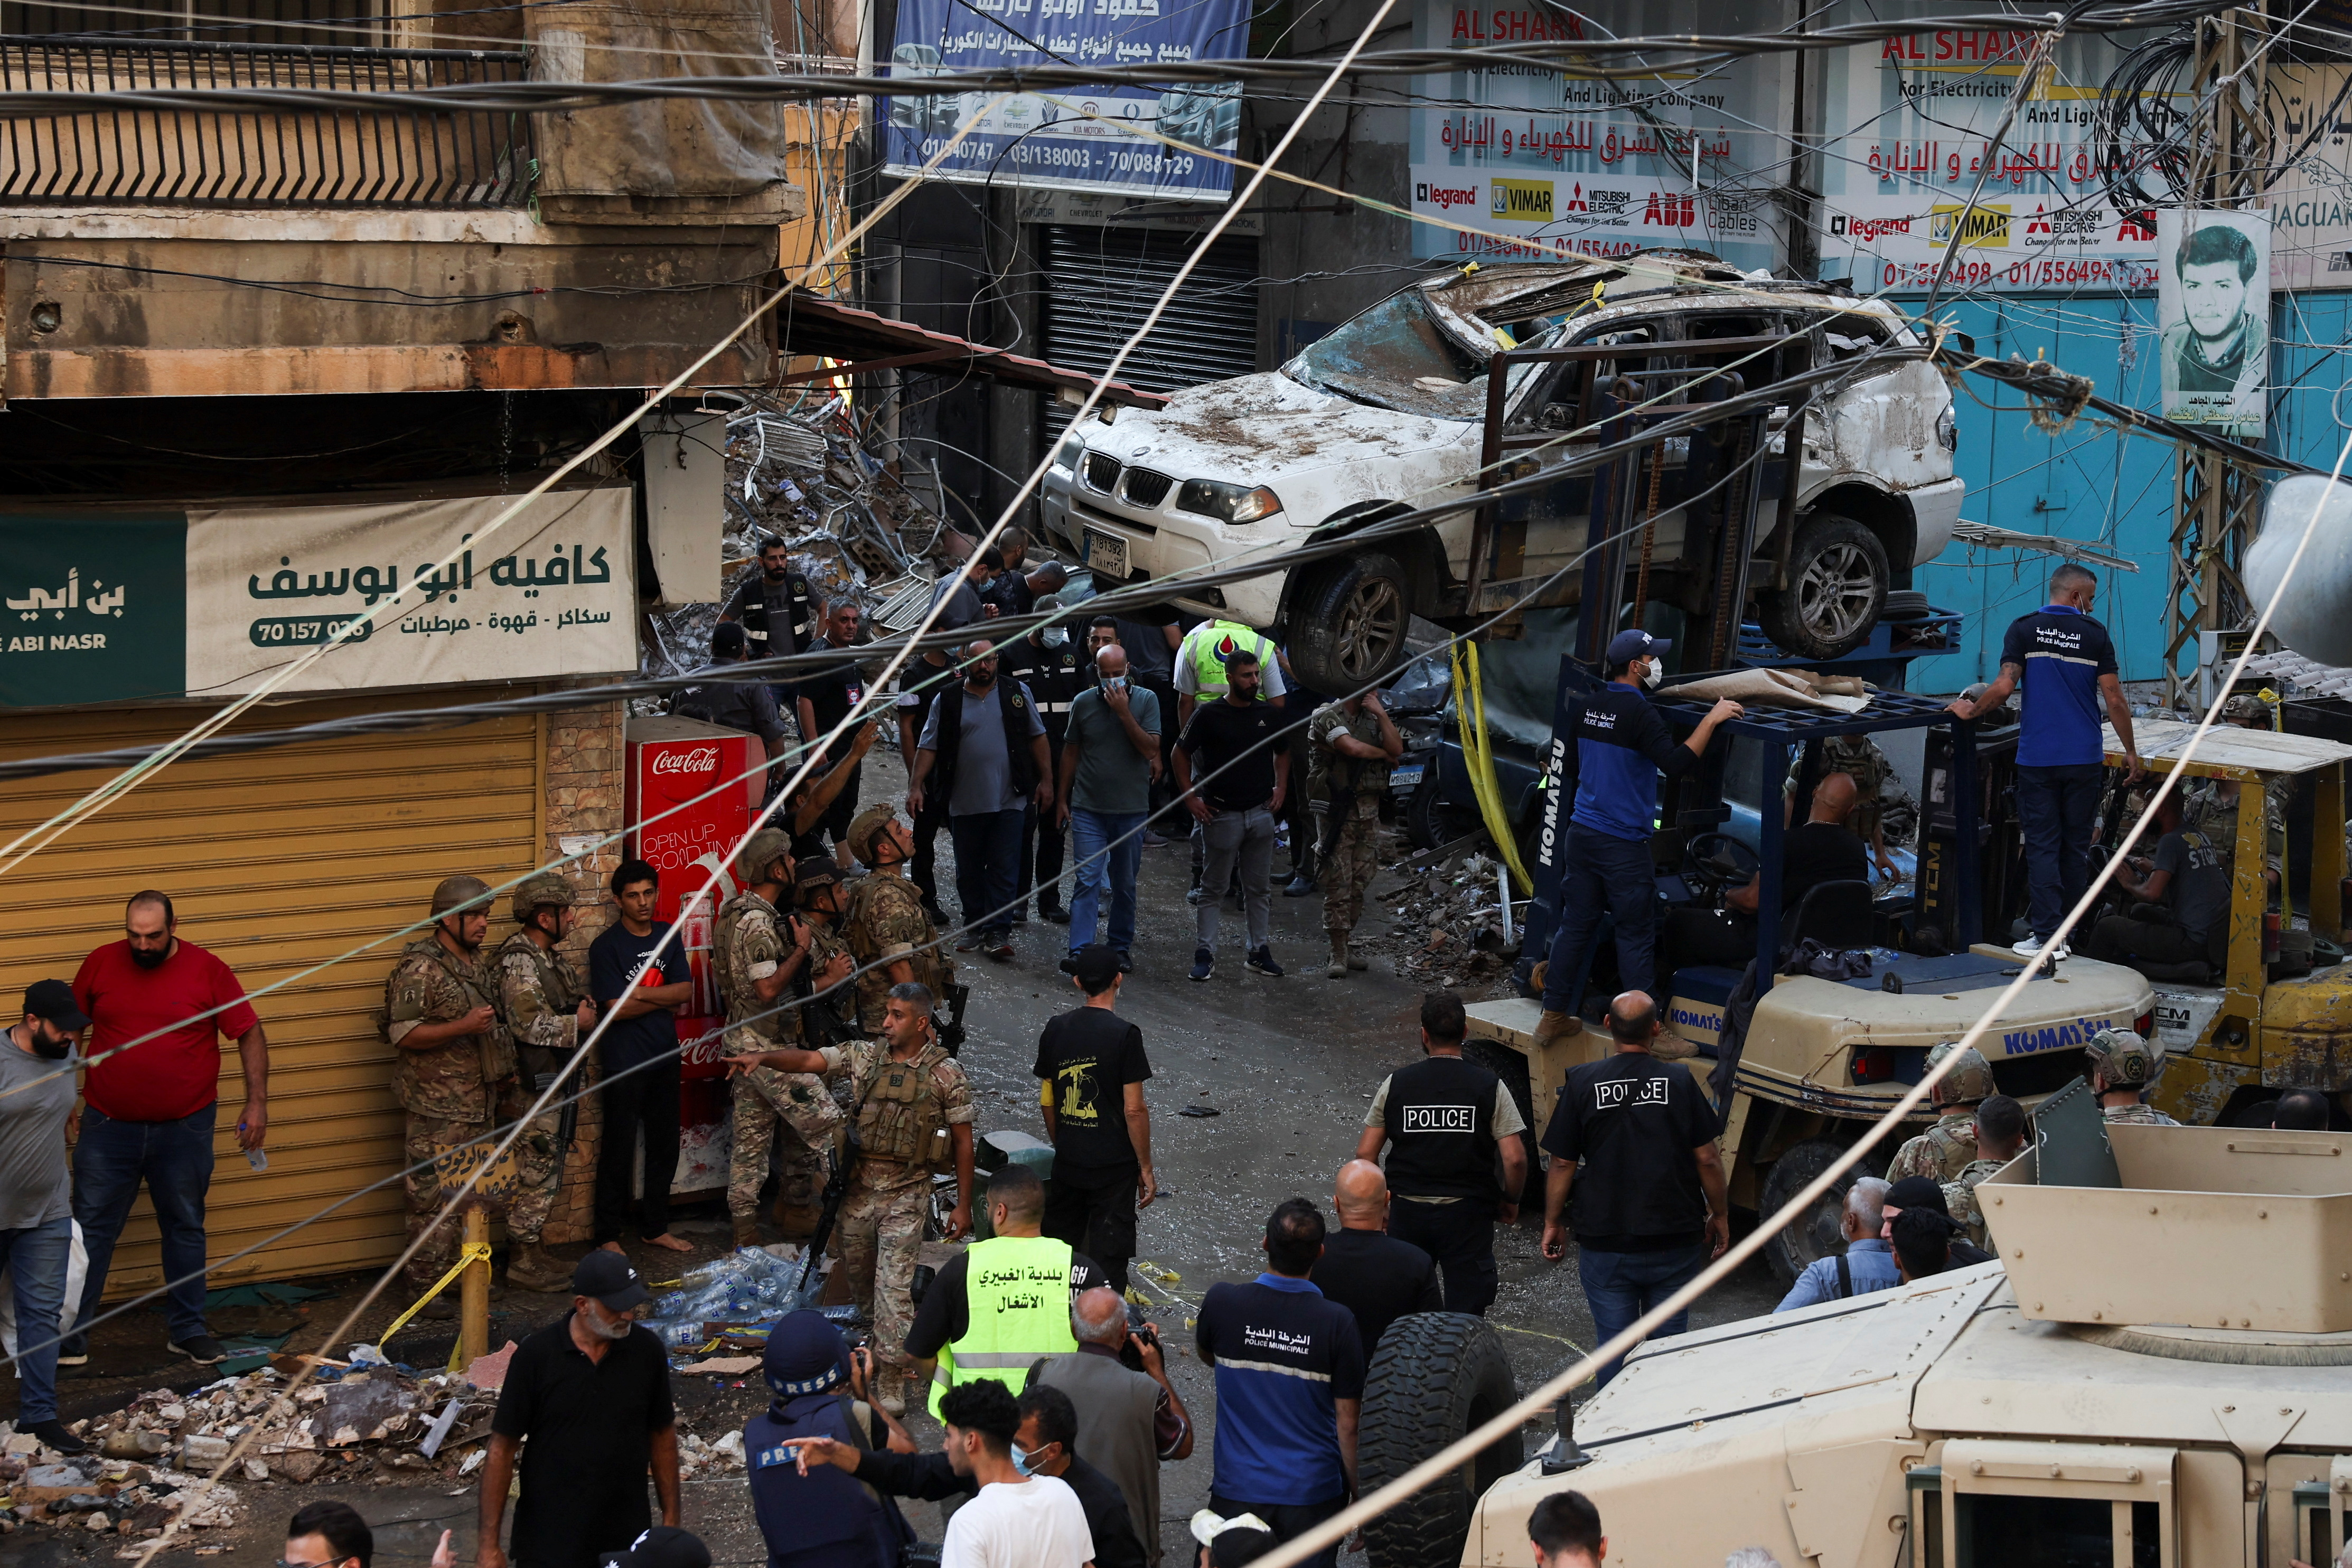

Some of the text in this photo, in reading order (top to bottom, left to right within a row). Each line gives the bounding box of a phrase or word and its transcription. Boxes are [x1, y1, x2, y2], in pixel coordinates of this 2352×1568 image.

[1451, 10, 1586, 42] AL SHARK
[939, 27, 983, 54] الكورية
[1048, 32, 1077, 54] قطع
[1079, 31, 1113, 61] أنواع
[1881, 30, 1926, 60] AL
[1115, 41, 1153, 64] جميع
[1564, 86, 1591, 104] And
[1898, 81, 1925, 98] For
[2027, 107, 2059, 124] And
[1084, 126, 1105, 135] MOTORS
[1520, 118, 1593, 163] للكهرباء
[1502, 129, 1513, 156] و
[1010, 144, 1090, 168] 03/138003
[1947, 152, 1961, 181] و
[1429, 183, 1476, 210] legrand
[1509, 187, 1552, 213] VIMAR
[1589, 190, 1631, 202] MITSUBISHI
[1070, 209, 1103, 218] CHEVROLET
[1589, 202, 1625, 214] ELECTRIC
[1643, 192, 1695, 227] ABB
[1567, 214, 1590, 224] Changes
[1611, 218, 1630, 227] Better
[1849, 215, 1910, 242] legrand
[2066, 237, 2078, 246] the
[2009, 259, 2112, 285] 01/556494
[2188, 393, 2235, 408] الشهيد المجاهد
[2200, 408, 2234, 425] مصطفى
[2235, 409, 2261, 426] عباس
[1096, 537, 1121, 556] 181392
[490, 544, 611, 598] كافيه
[6, 567, 125, 621] بن أبي
[400, 615, 470, 637] مرطبات
[488, 609, 537, 633] قهوة
[557, 608, 611, 630] سكاكر
[8, 635, 44, 652] ABI
[50, 633, 106, 650] NASR
[258, 623, 284, 642] 70
[289, 623, 319, 640] 157
[2036, 627, 2081, 641] الشرطة البلدية
[1583, 717, 1597, 726] POLICE
[653, 747, 720, 775] Coca-Cola
[1539, 737, 1566, 867] KOMATSU
[643, 824, 716, 853] OPEN UP
[625, 962, 643, 982] ROCK
[1670, 1008, 1722, 1032] KOMATS
[1408, 1109, 1469, 1128] POLICE
[979, 1265, 1063, 1287] بلدية الغبيري
[997, 1292, 1044, 1313] الأشغال
[1244, 1338, 1309, 1355] POLICE MUNICIPALE
[1245, 1325, 1311, 1346] الشرطة البلدية
[774, 1367, 838, 1394] PRESS
